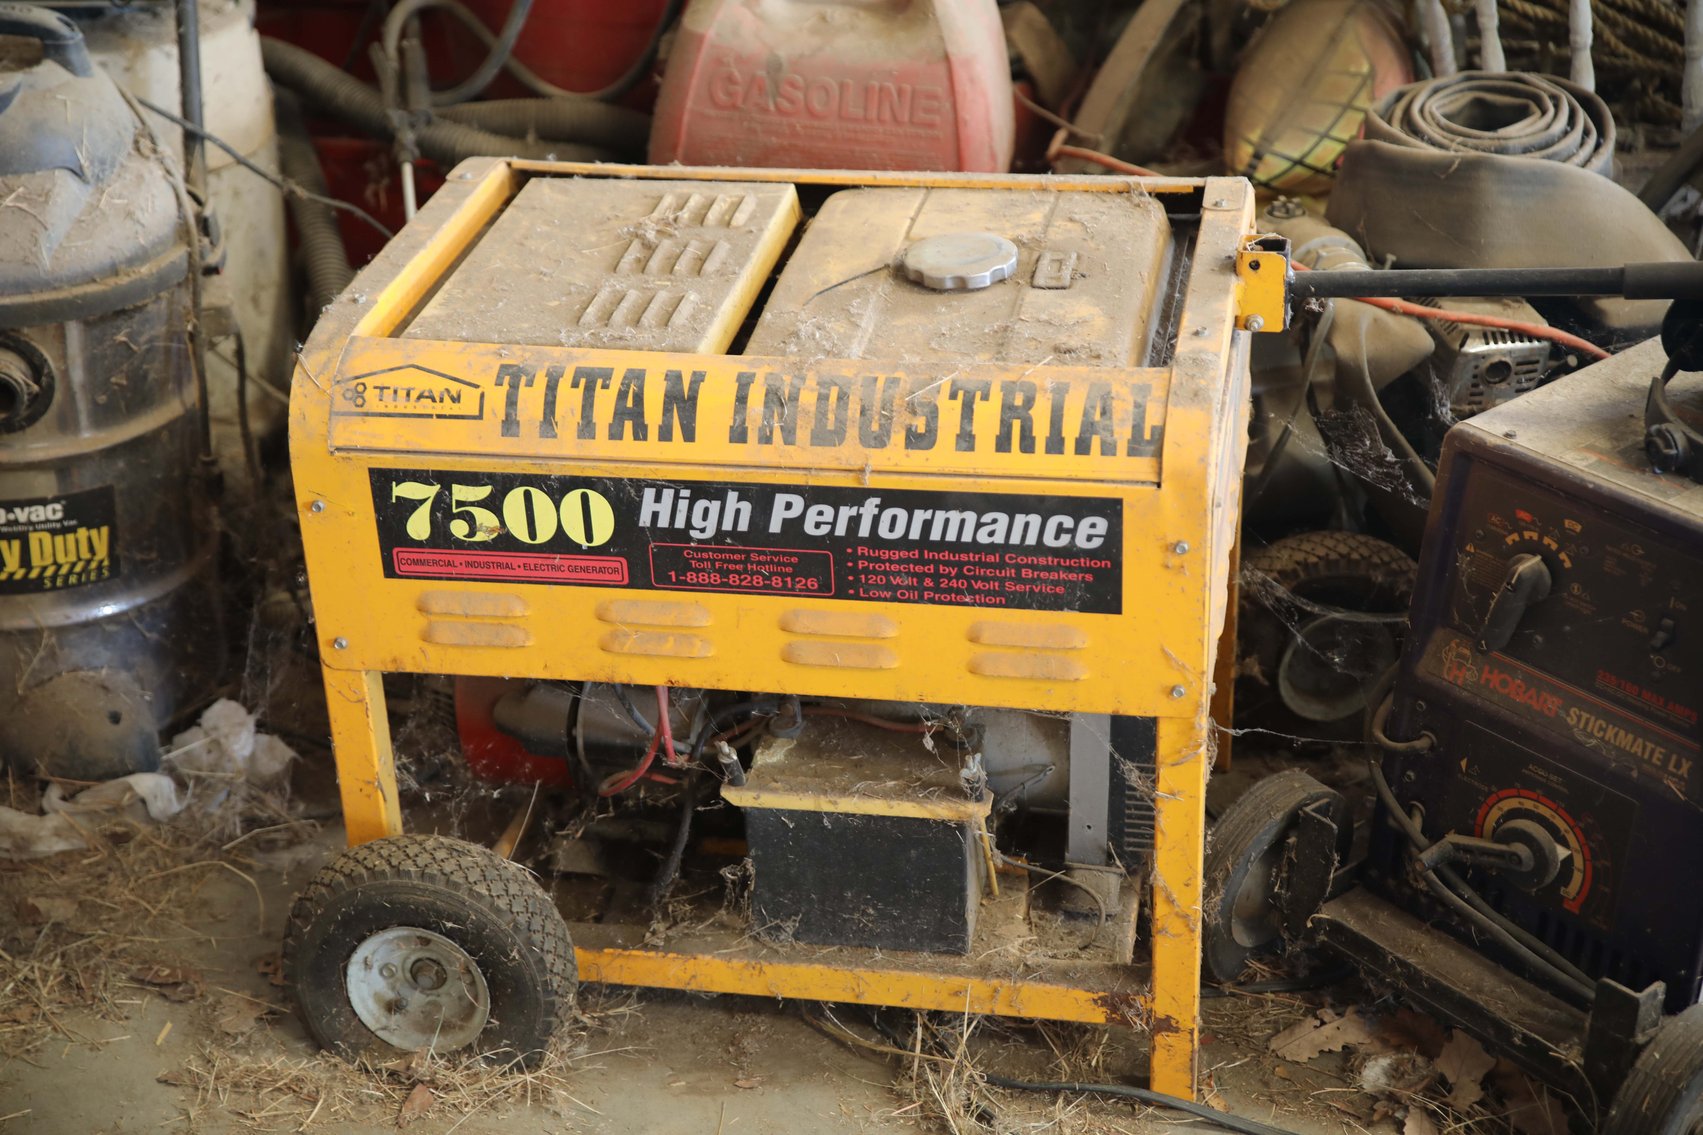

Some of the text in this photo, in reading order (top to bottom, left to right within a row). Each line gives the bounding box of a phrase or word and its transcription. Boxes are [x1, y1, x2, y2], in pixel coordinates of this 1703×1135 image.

[709, 68, 942, 127] GASOLINE
[373, 386, 461, 404] TITAN
[494, 363, 1164, 457] TITAN INDUSTRIAL
[391, 480, 1109, 549] 7500 High Performance
[28, 525, 110, 567] Duty
[683, 549, 799, 564] Customer Service
[400, 557, 620, 575] COMMERCIAL INDUSTRIAL ELECTRIC GENERATOR
[689, 560, 793, 574] Toll Free Hotline
[857, 546, 1112, 569] Rugged Industrial Construction
[43, 568, 110, 589] SERIES
[668, 571, 818, 590] 1-888-828-8126
[858, 560, 1094, 582] Protected by Circuit Breakers
[859, 574, 1066, 594] 120 Volt & 240 Volt Service
[859, 588, 1006, 605] Low Oil Protection
[1566, 707, 1666, 766] STICKMATE
[1667, 754, 1694, 779] LX
